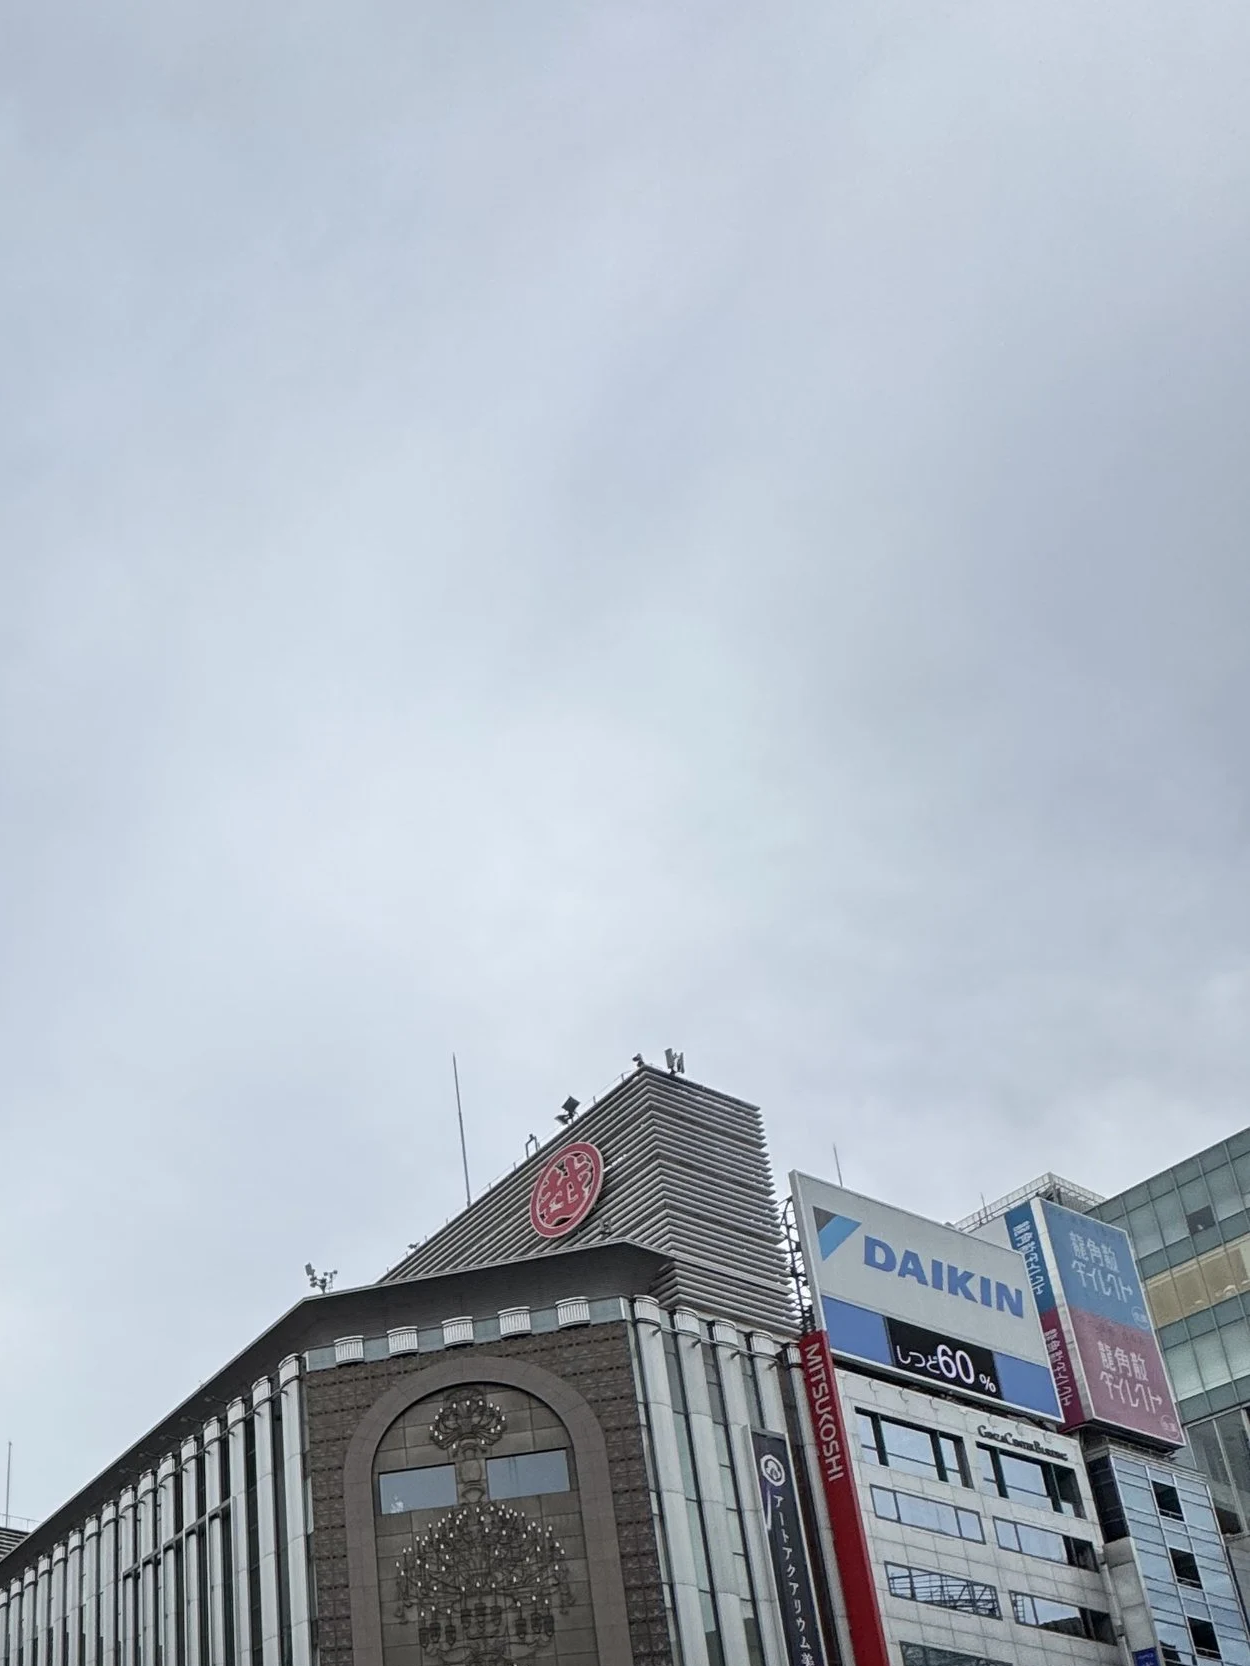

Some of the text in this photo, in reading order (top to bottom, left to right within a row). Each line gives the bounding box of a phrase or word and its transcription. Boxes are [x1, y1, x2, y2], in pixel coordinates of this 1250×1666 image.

[863, 1234, 1024, 1319] DAIKIN
[1072, 1259, 1134, 1303] ダイレクト
[804, 1342, 844, 1482] MITSUKOSHI
[1100, 1370, 1163, 1414] ダイレクト
